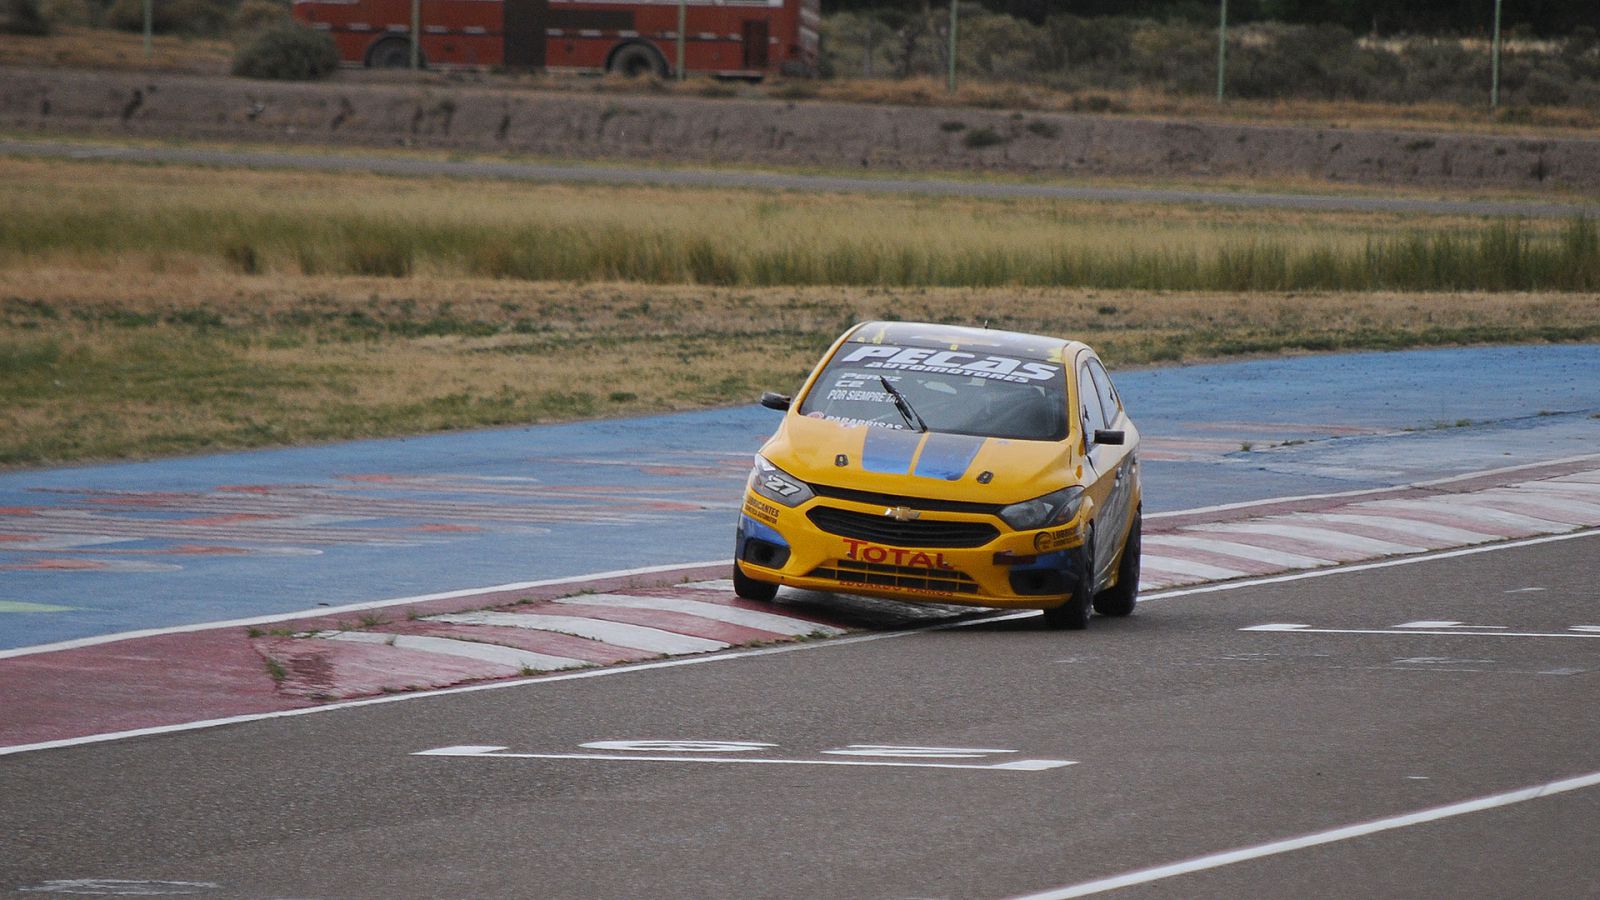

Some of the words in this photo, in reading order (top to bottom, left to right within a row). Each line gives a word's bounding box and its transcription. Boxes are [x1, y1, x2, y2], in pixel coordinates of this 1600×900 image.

[841, 345, 1060, 381] PECAS
[865, 361, 1029, 383] AUTOMOTORES
[827, 389, 845, 401] POR
[846, 390, 886, 403] SIEMPRE
[765, 474, 801, 497] 27
[841, 538, 956, 570] TOTAL
